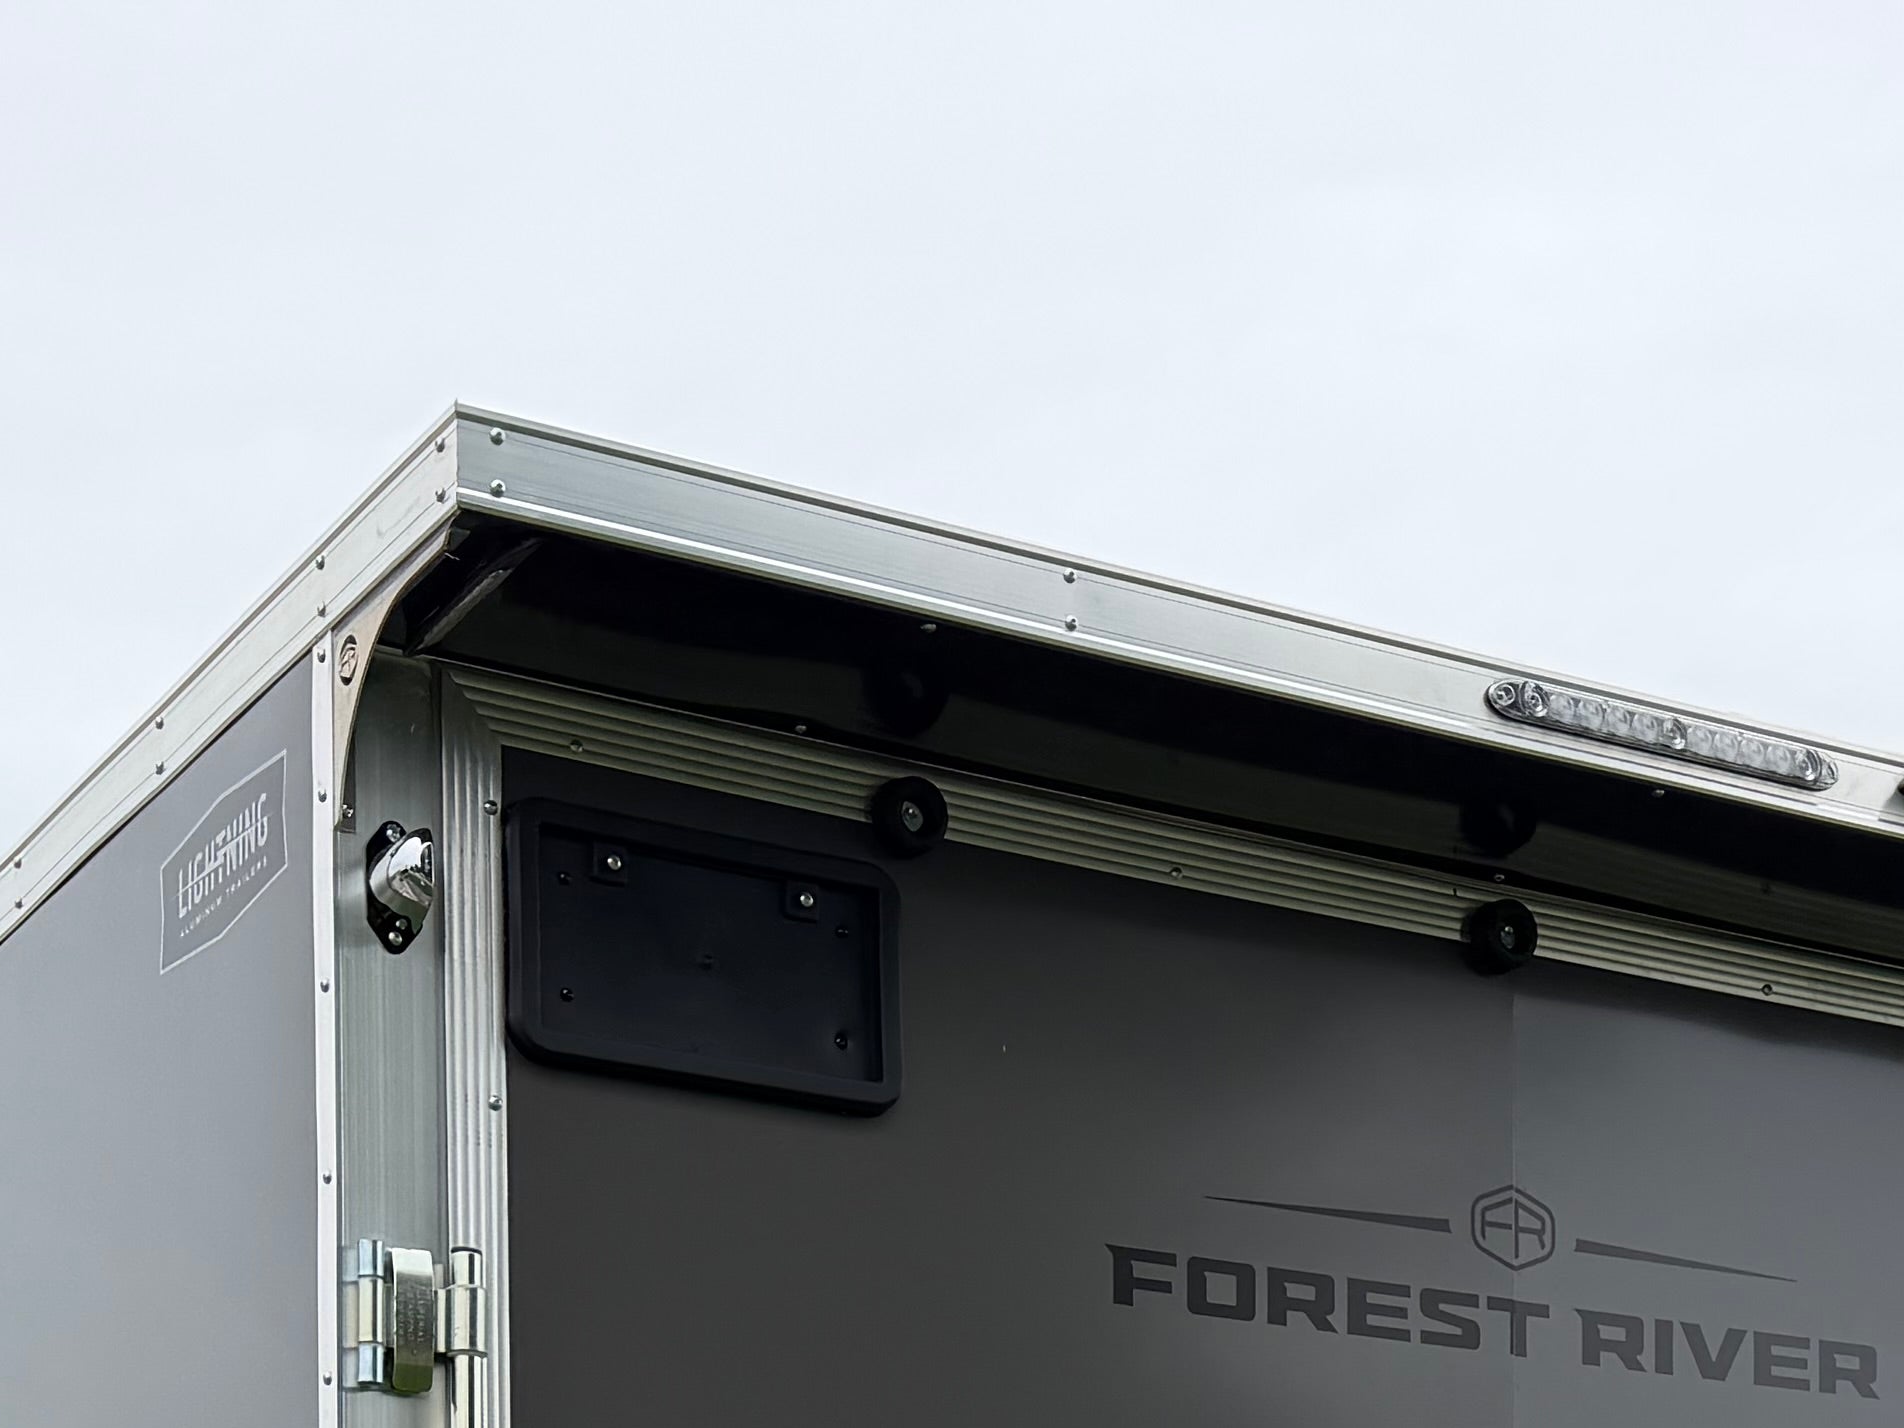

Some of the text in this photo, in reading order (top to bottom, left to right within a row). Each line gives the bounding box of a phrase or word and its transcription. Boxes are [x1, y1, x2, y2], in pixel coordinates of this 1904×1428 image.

[178, 793, 268, 919] LIGHTNING
[1104, 1243, 1881, 1400] FOREST RIVER
